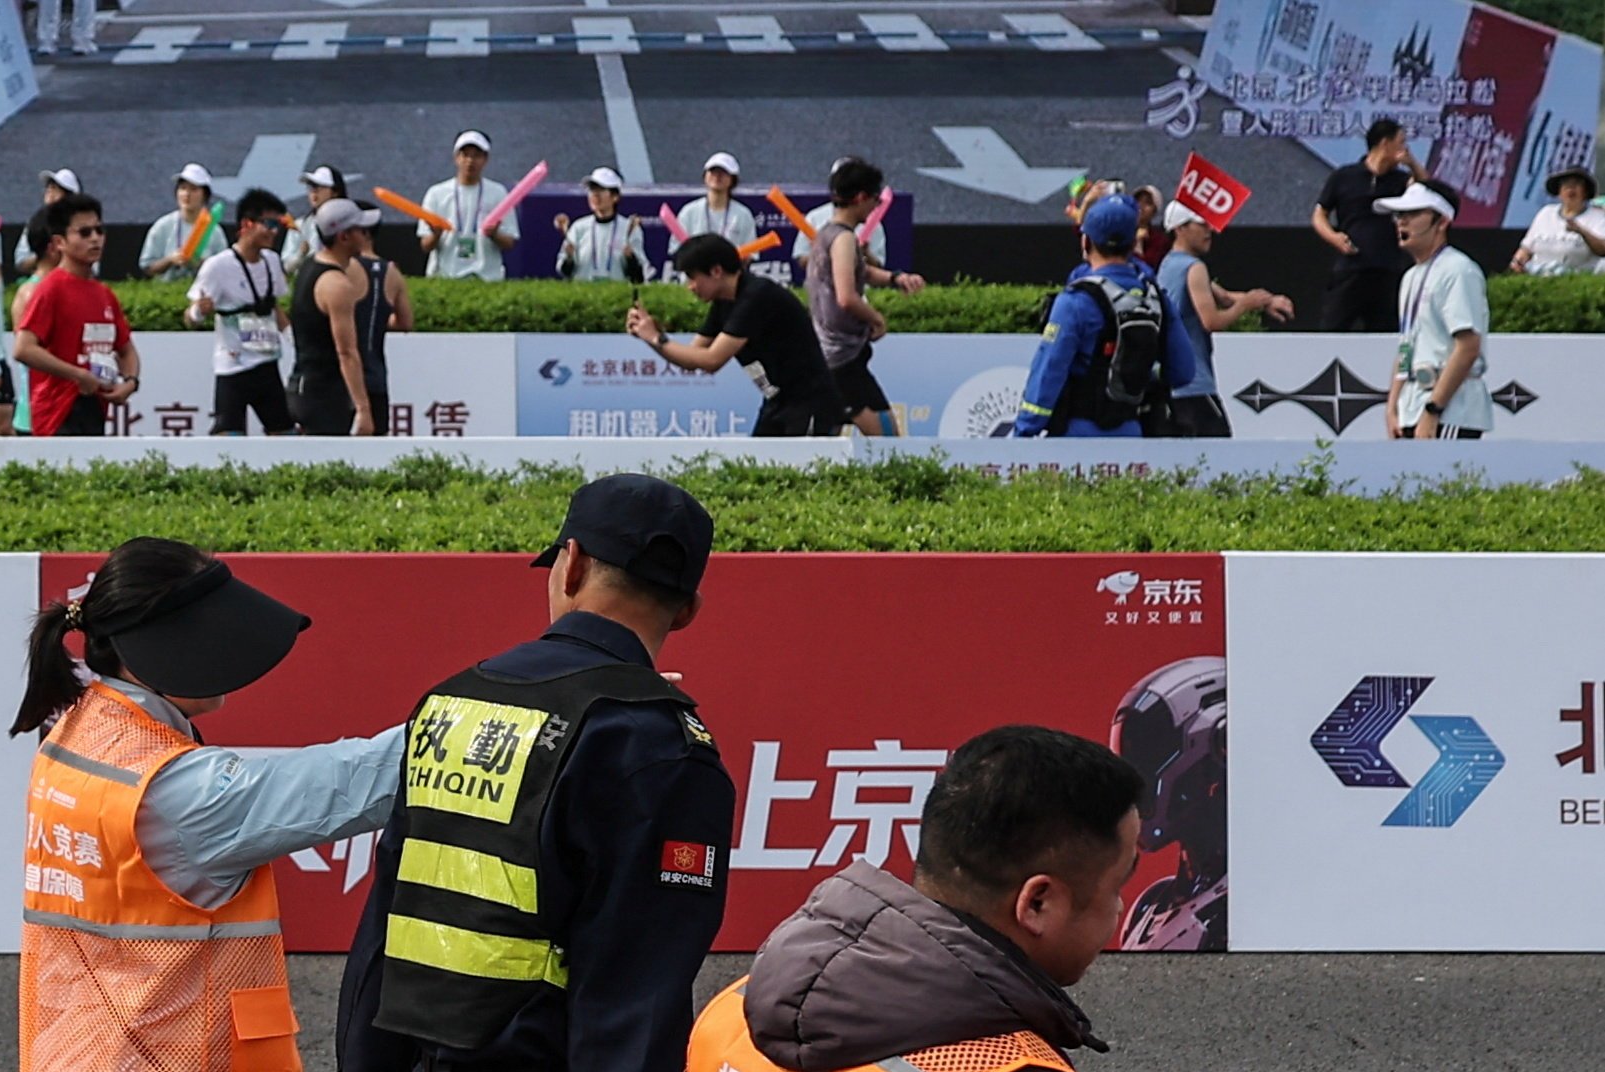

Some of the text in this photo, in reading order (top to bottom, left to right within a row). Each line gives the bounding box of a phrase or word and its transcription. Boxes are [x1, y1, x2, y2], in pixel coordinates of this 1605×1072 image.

[1181, 169, 1234, 214] AED
[582, 359, 716, 377] 北京机器人
[1142, 579, 1202, 605] 京东
[1104, 611, 1203, 625] 又好又便宜
[412, 710, 521, 776] 执勤
[409, 766, 505, 804] ZHIQIN
